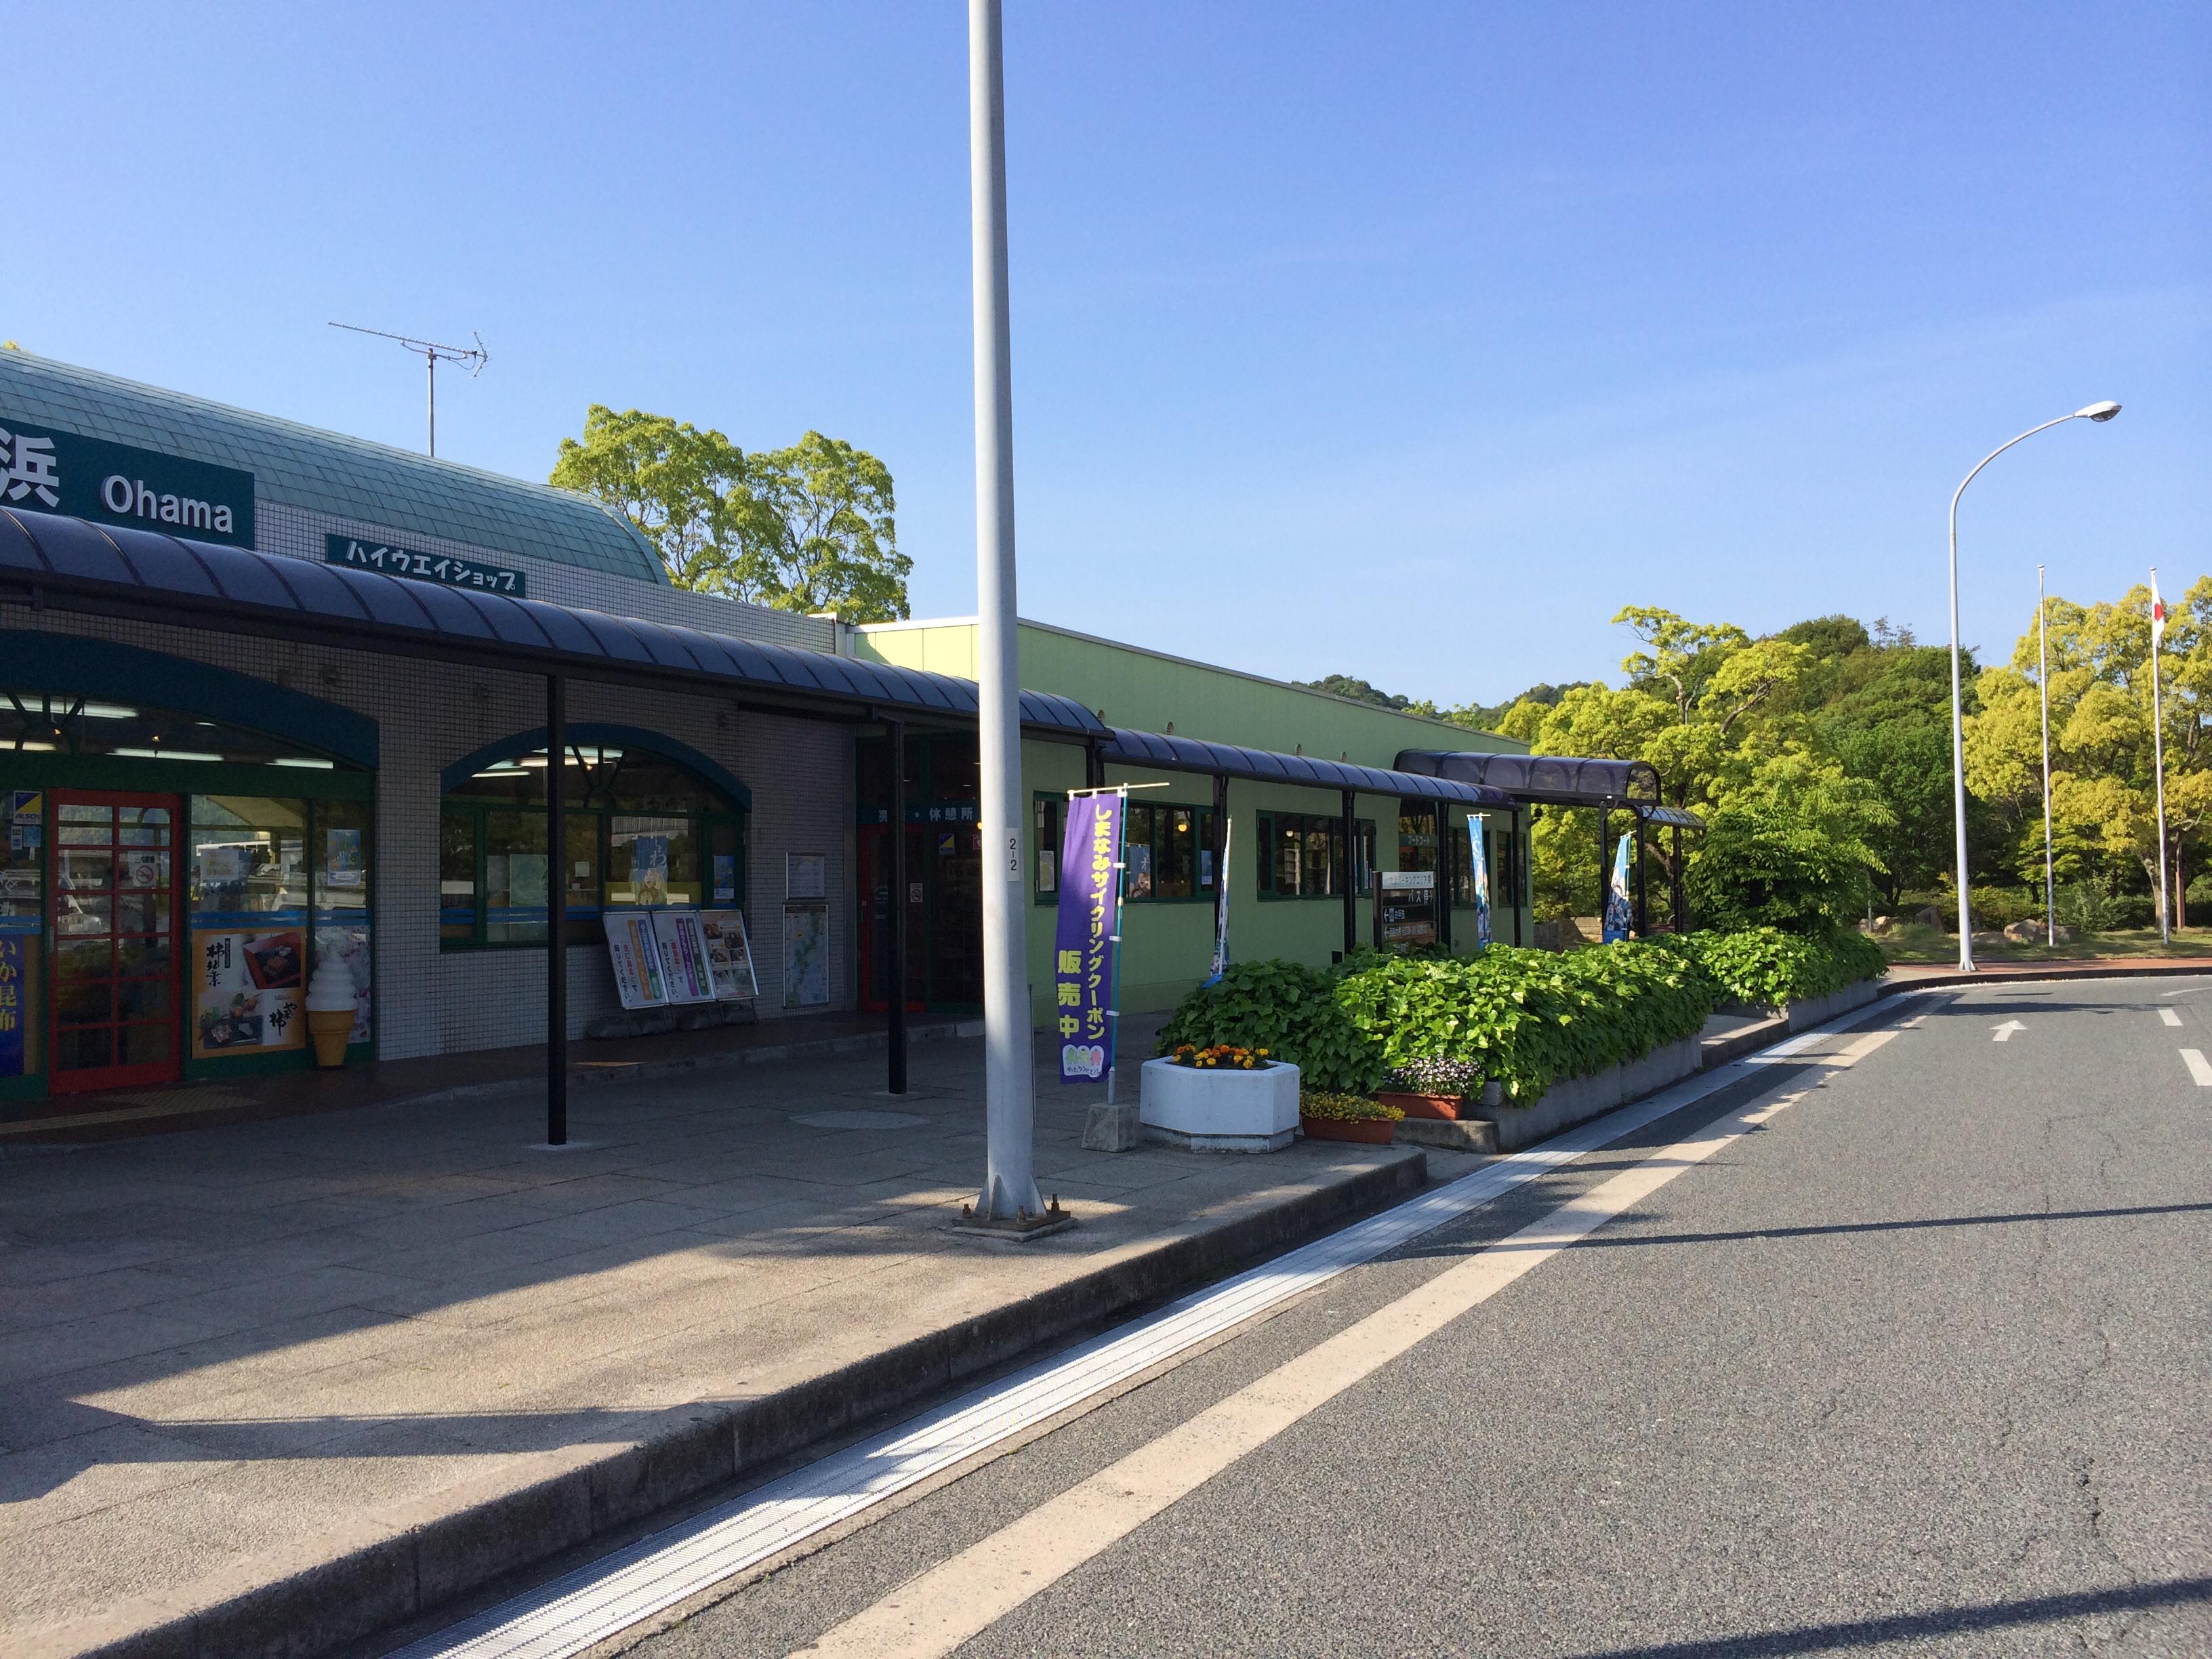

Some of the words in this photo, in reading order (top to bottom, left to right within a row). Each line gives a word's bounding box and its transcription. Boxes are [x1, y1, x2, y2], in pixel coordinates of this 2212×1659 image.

[100, 474, 233, 534] Ohama
[346, 539, 517, 592] ハイウエイショップ
[878, 807, 973, 822] 売・休憩所
[1009, 838, 1017, 871] 2-2
[1087, 804, 1112, 1040] しまなみサイクリングクーポン
[1057, 949, 1082, 1039] 販売中
